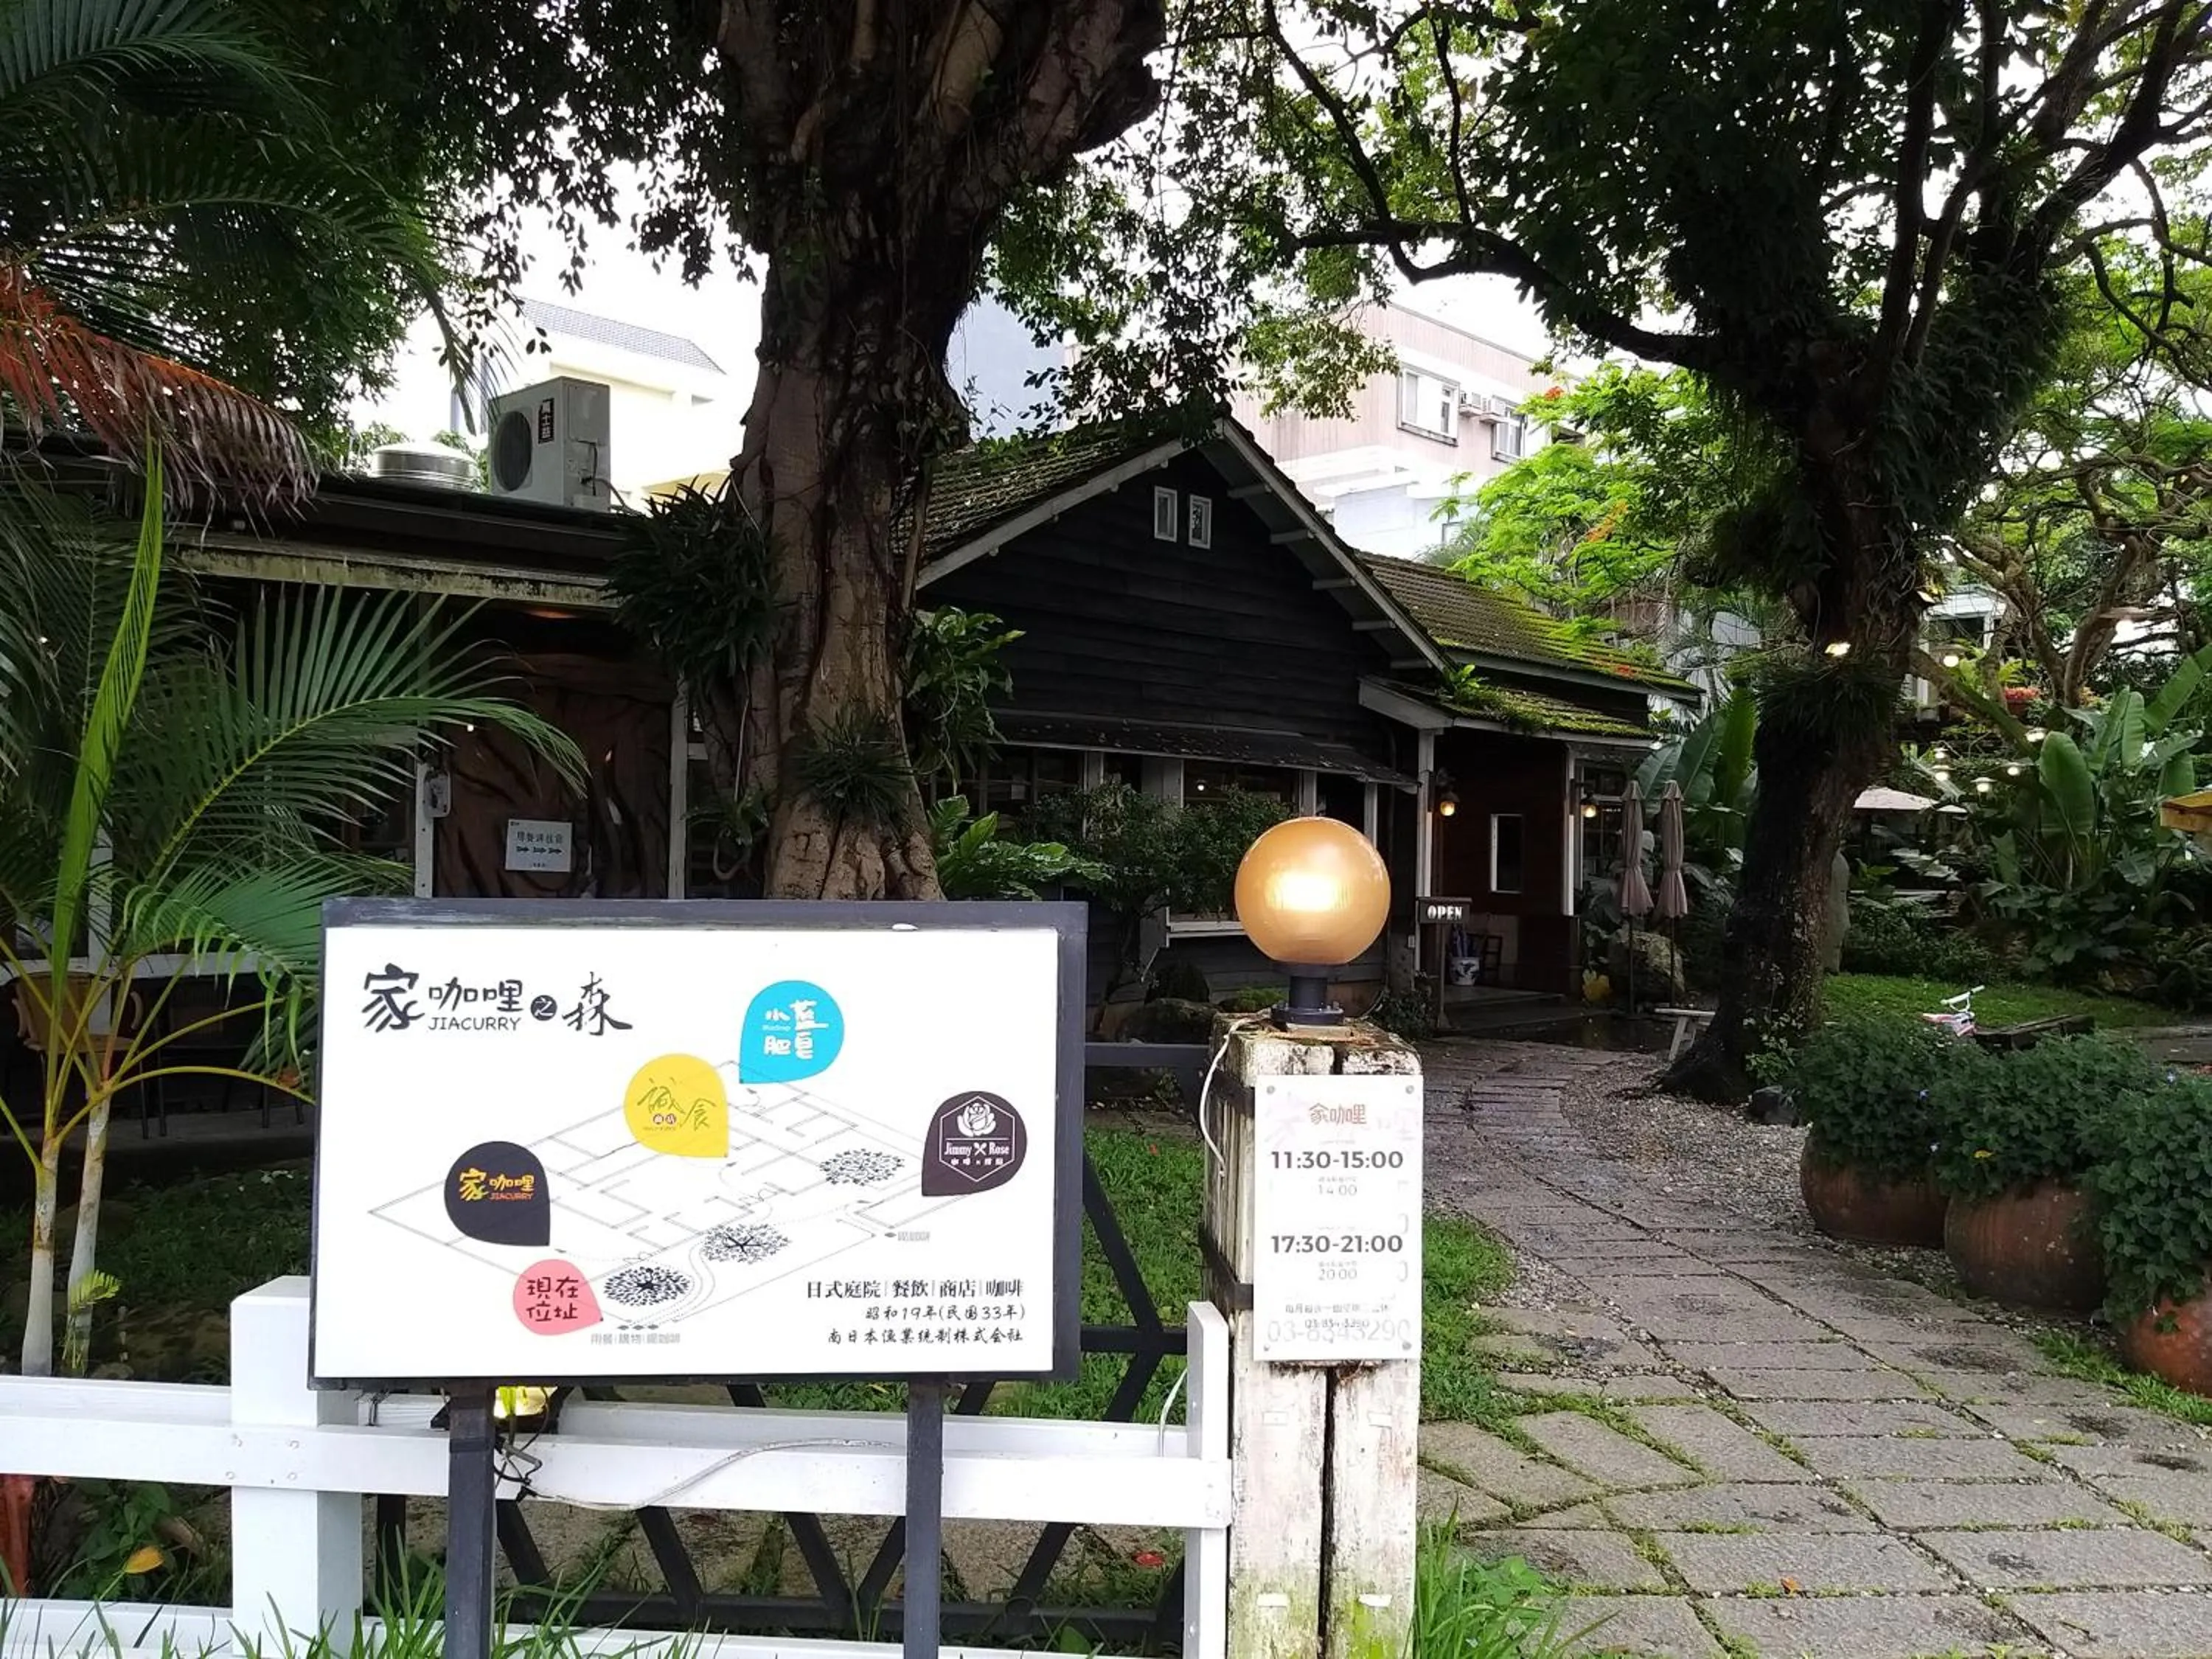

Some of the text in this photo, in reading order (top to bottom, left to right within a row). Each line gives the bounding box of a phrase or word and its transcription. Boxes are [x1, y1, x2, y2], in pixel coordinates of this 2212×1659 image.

[1427, 905, 1463, 919] OPEN
[428, 1017, 521, 1032] JIACURRY
[1270, 1150, 1404, 1169] 11:30-15:00
[1270, 1235, 1403, 1253] 17:30-21:00
[526, 1276, 578, 1298] 現在
[526, 1302, 578, 1322] 位址
